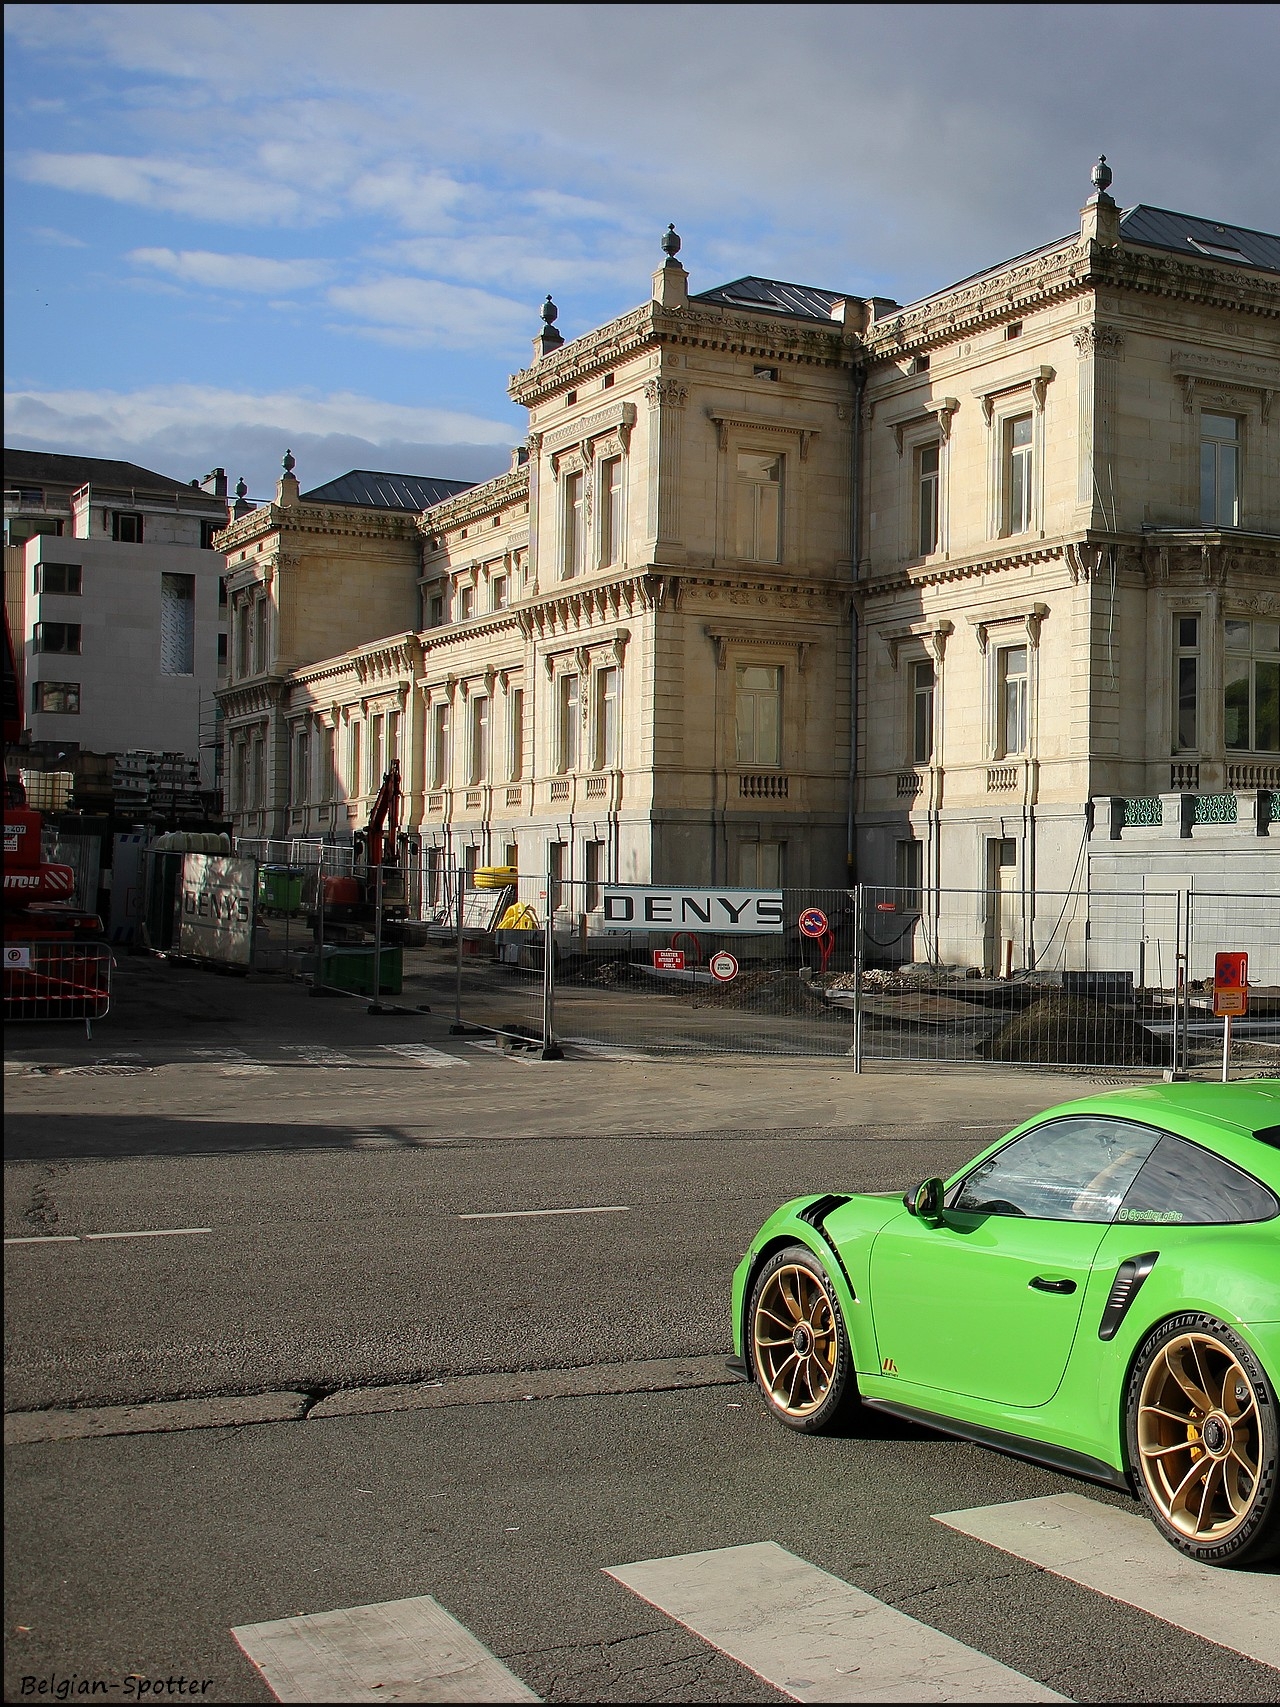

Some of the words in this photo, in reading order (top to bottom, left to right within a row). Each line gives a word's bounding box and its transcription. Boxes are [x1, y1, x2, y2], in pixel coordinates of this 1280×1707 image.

[186, 891, 249, 922] DENYS
[604, 896, 782, 925] DENYS
[836, 1313, 846, 1374] MICHELIN
[1144, 1315, 1195, 1356] MICHELIN
[1199, 1525, 1253, 1559] MICHELIN
